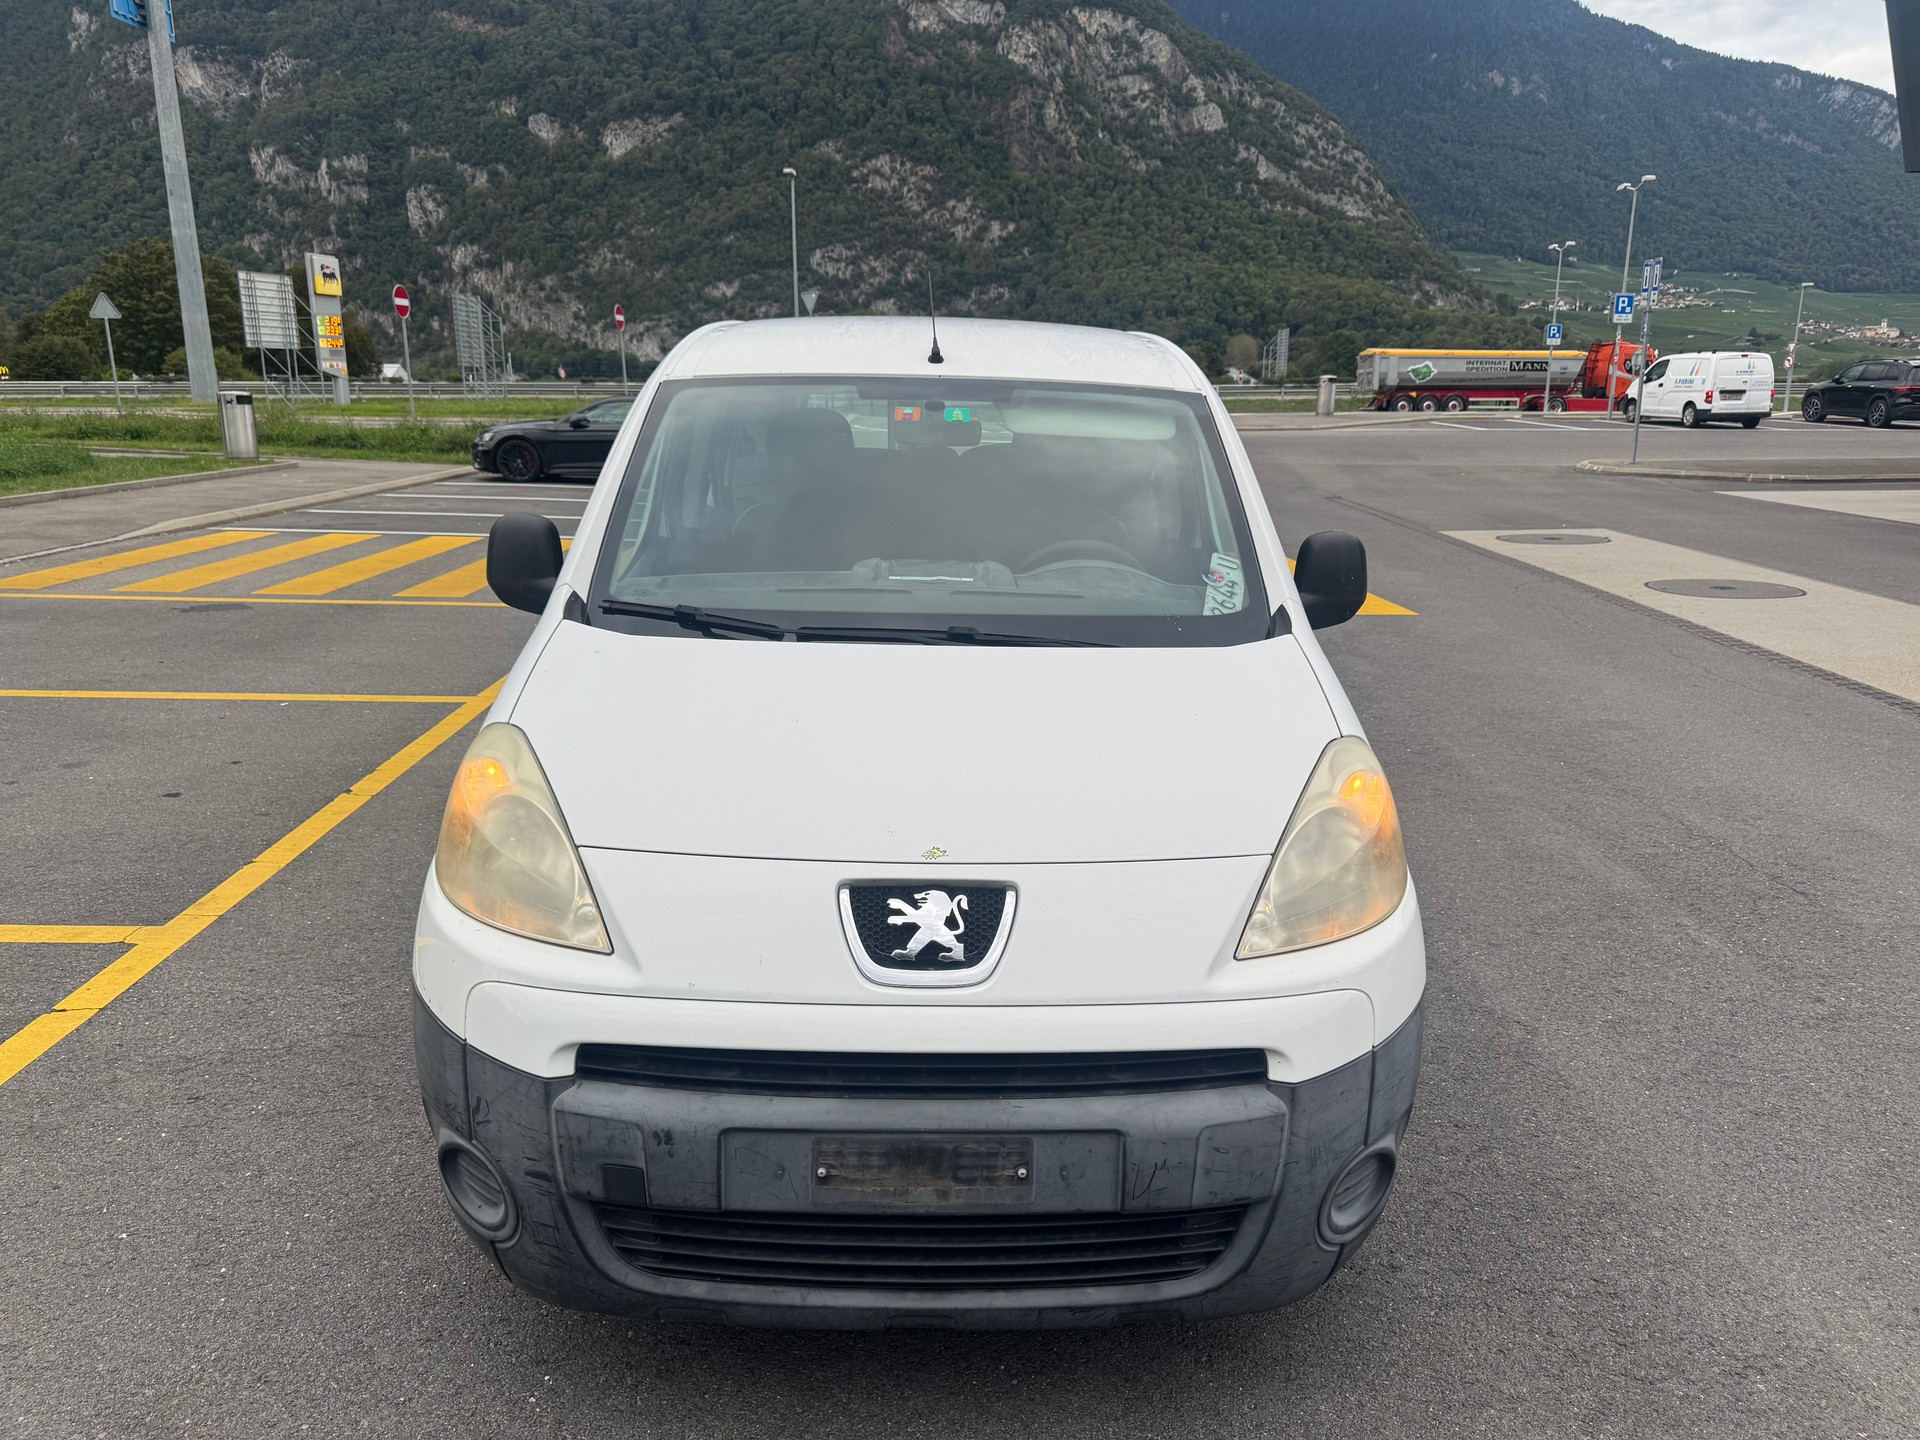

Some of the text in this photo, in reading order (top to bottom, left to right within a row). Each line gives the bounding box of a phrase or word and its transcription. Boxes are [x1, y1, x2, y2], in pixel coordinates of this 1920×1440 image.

[1618, 297, 1628, 312] P
[1550, 326, 1557, 337] P
[1511, 362, 1549, 371] MANN
[1217, 556, 1239, 570] U
